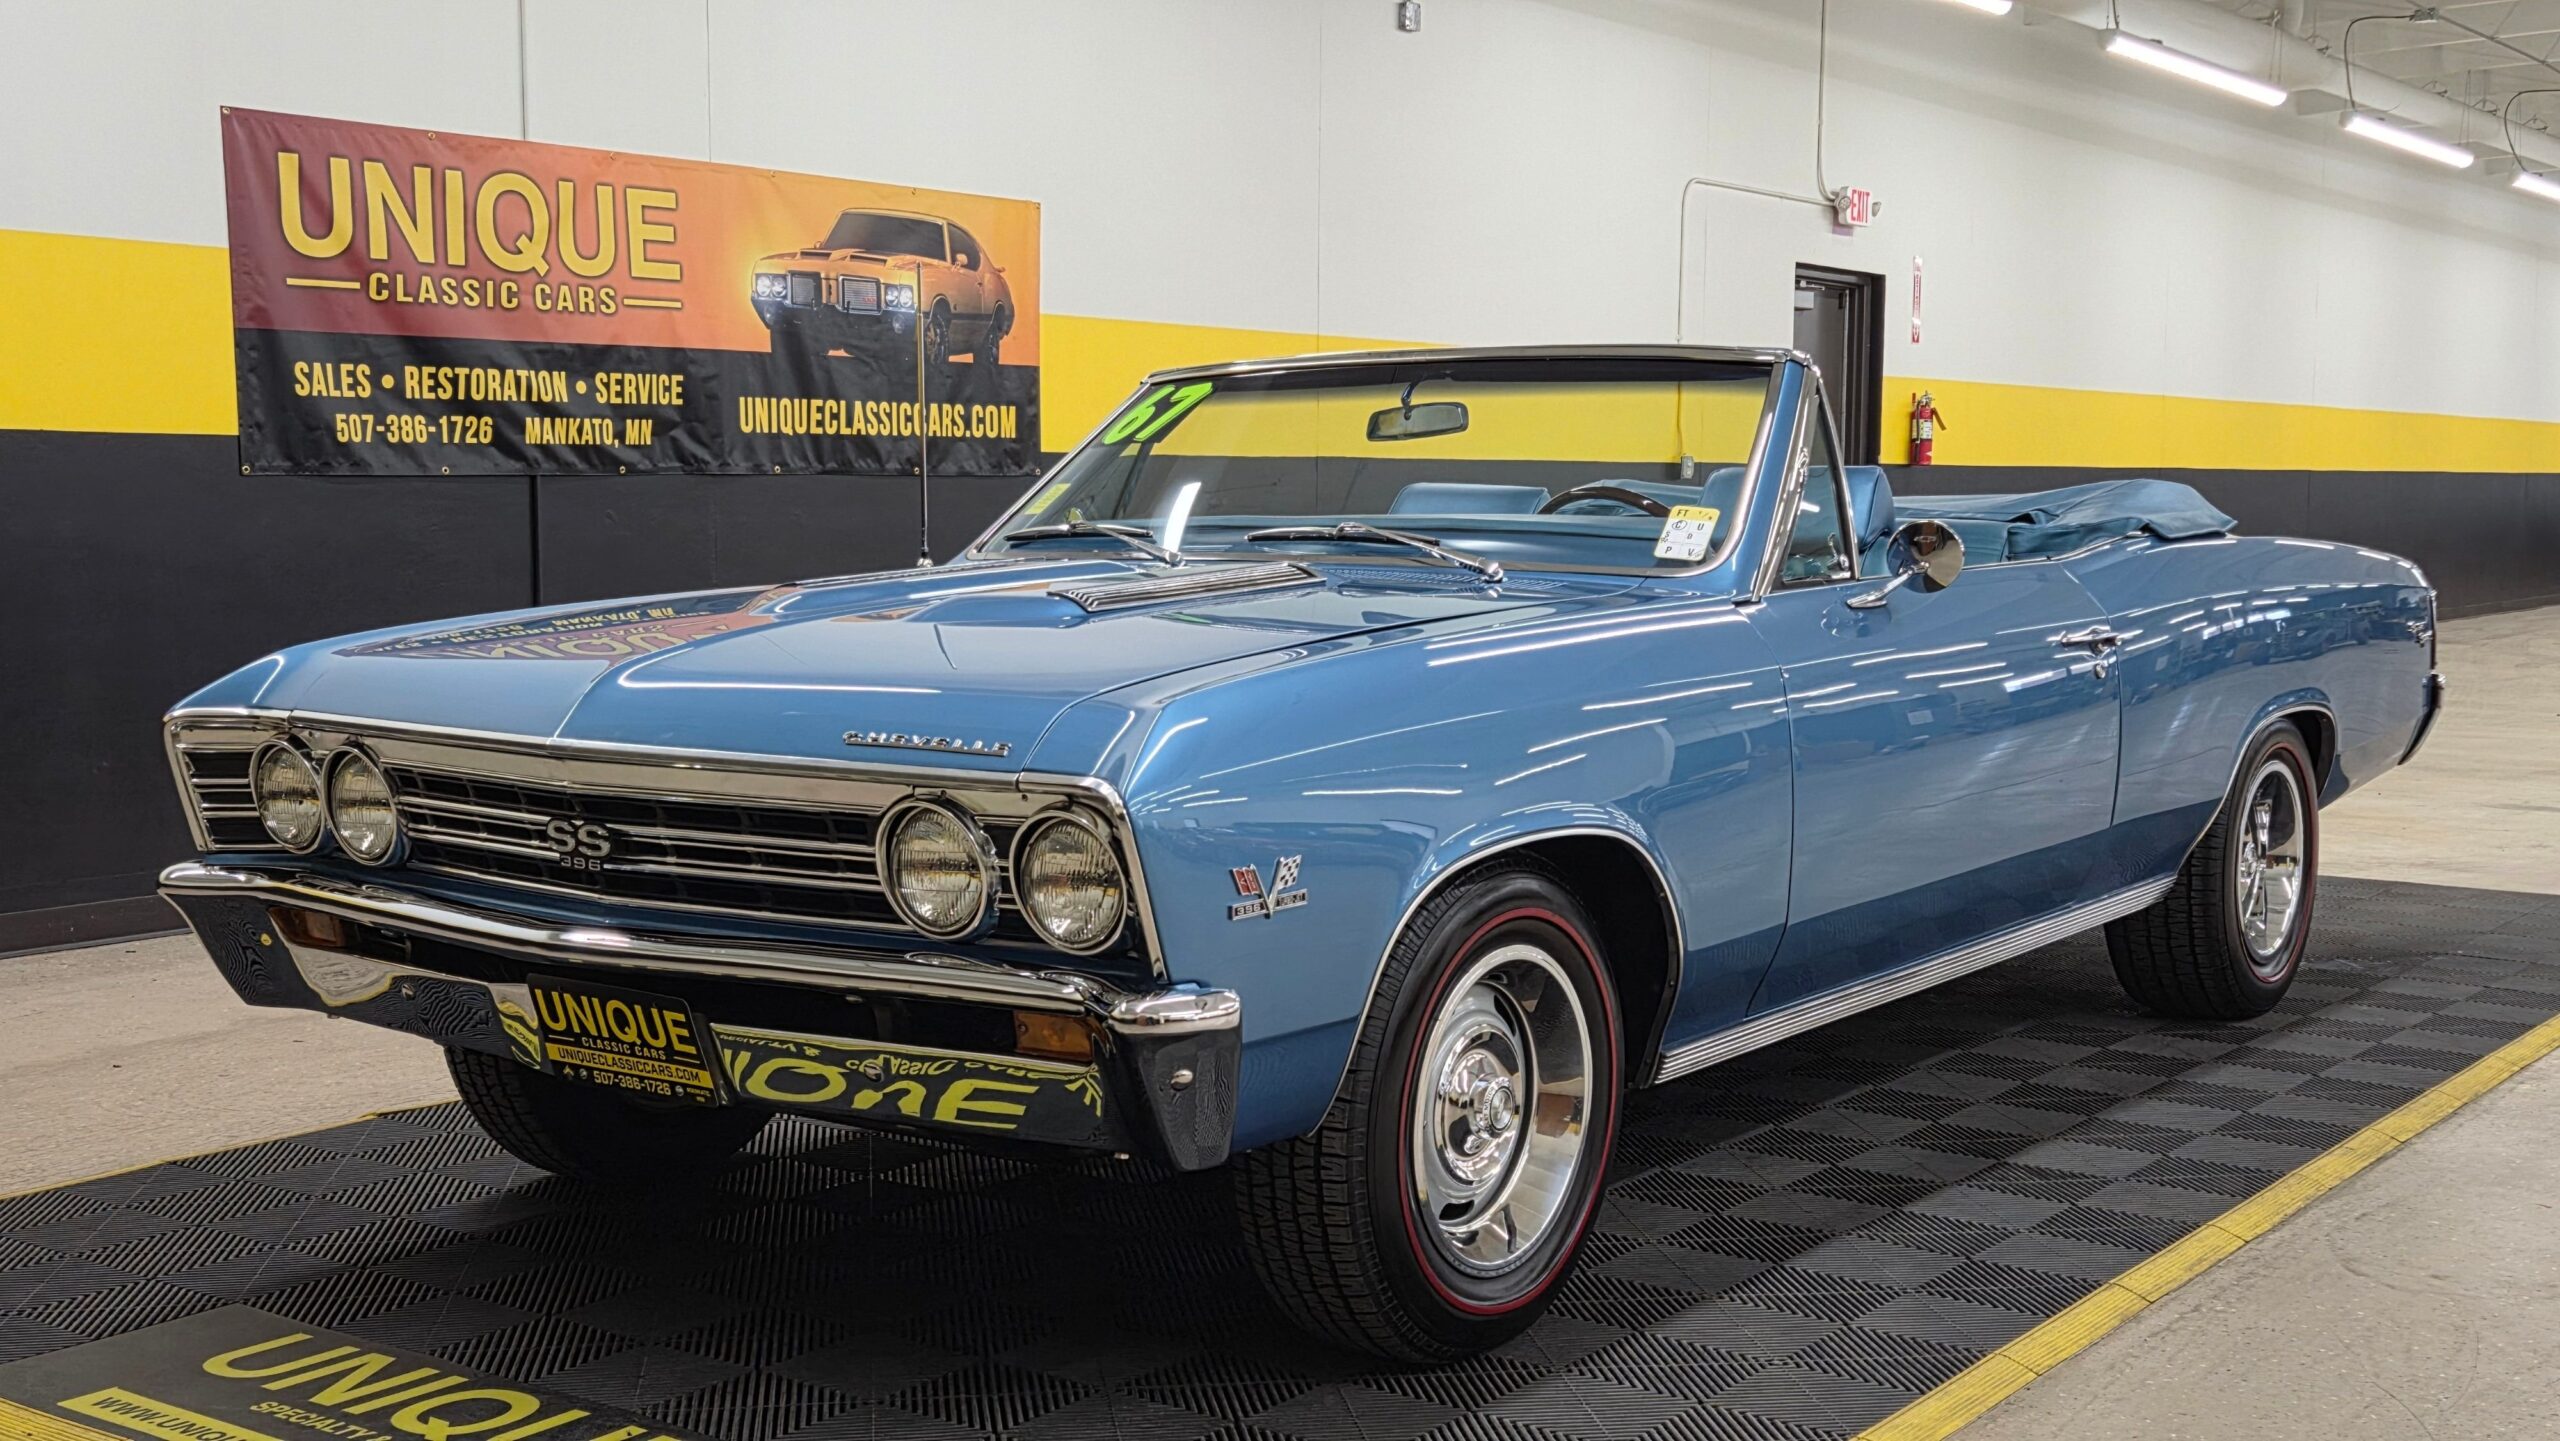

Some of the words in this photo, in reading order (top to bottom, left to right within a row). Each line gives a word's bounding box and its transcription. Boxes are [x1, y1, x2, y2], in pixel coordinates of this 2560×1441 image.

[277, 151, 682, 281] UNIQUE
[1851, 189, 1870, 223] EXIT
[368, 272, 520, 309] CLASSIC
[535, 284, 617, 314] CARS
[294, 361, 371, 397] SALES
[404, 366, 568, 402] RESTORATION
[595, 372, 684, 405] SERVICE
[336, 414, 493, 445] 507-386-1726
[525, 417, 619, 448] MANKATO,
[625, 419, 652, 446] MN
[739, 396, 1017, 439] UNIQUECLASSICCARS.COM
[1102, 382, 1213, 445] 67
[546, 820, 611, 857] SS
[560, 855, 601, 871] 396
[1236, 903, 1262, 916] 396
[534, 989, 697, 1055] UNIQUE
[557, 1047, 701, 1083] UNIQUECLASSICCARS.COM
[581, 1036, 631, 1055] CLASSIC
[634, 1047, 667, 1060] CARS
[593, 1070, 672, 1096] 507-386-1726
[202, 1333, 682, 1441] UNIQ
[91, 1396, 249, 1441] WWW.UNIQ
[249, 1401, 378, 1439] SPECIALTY
